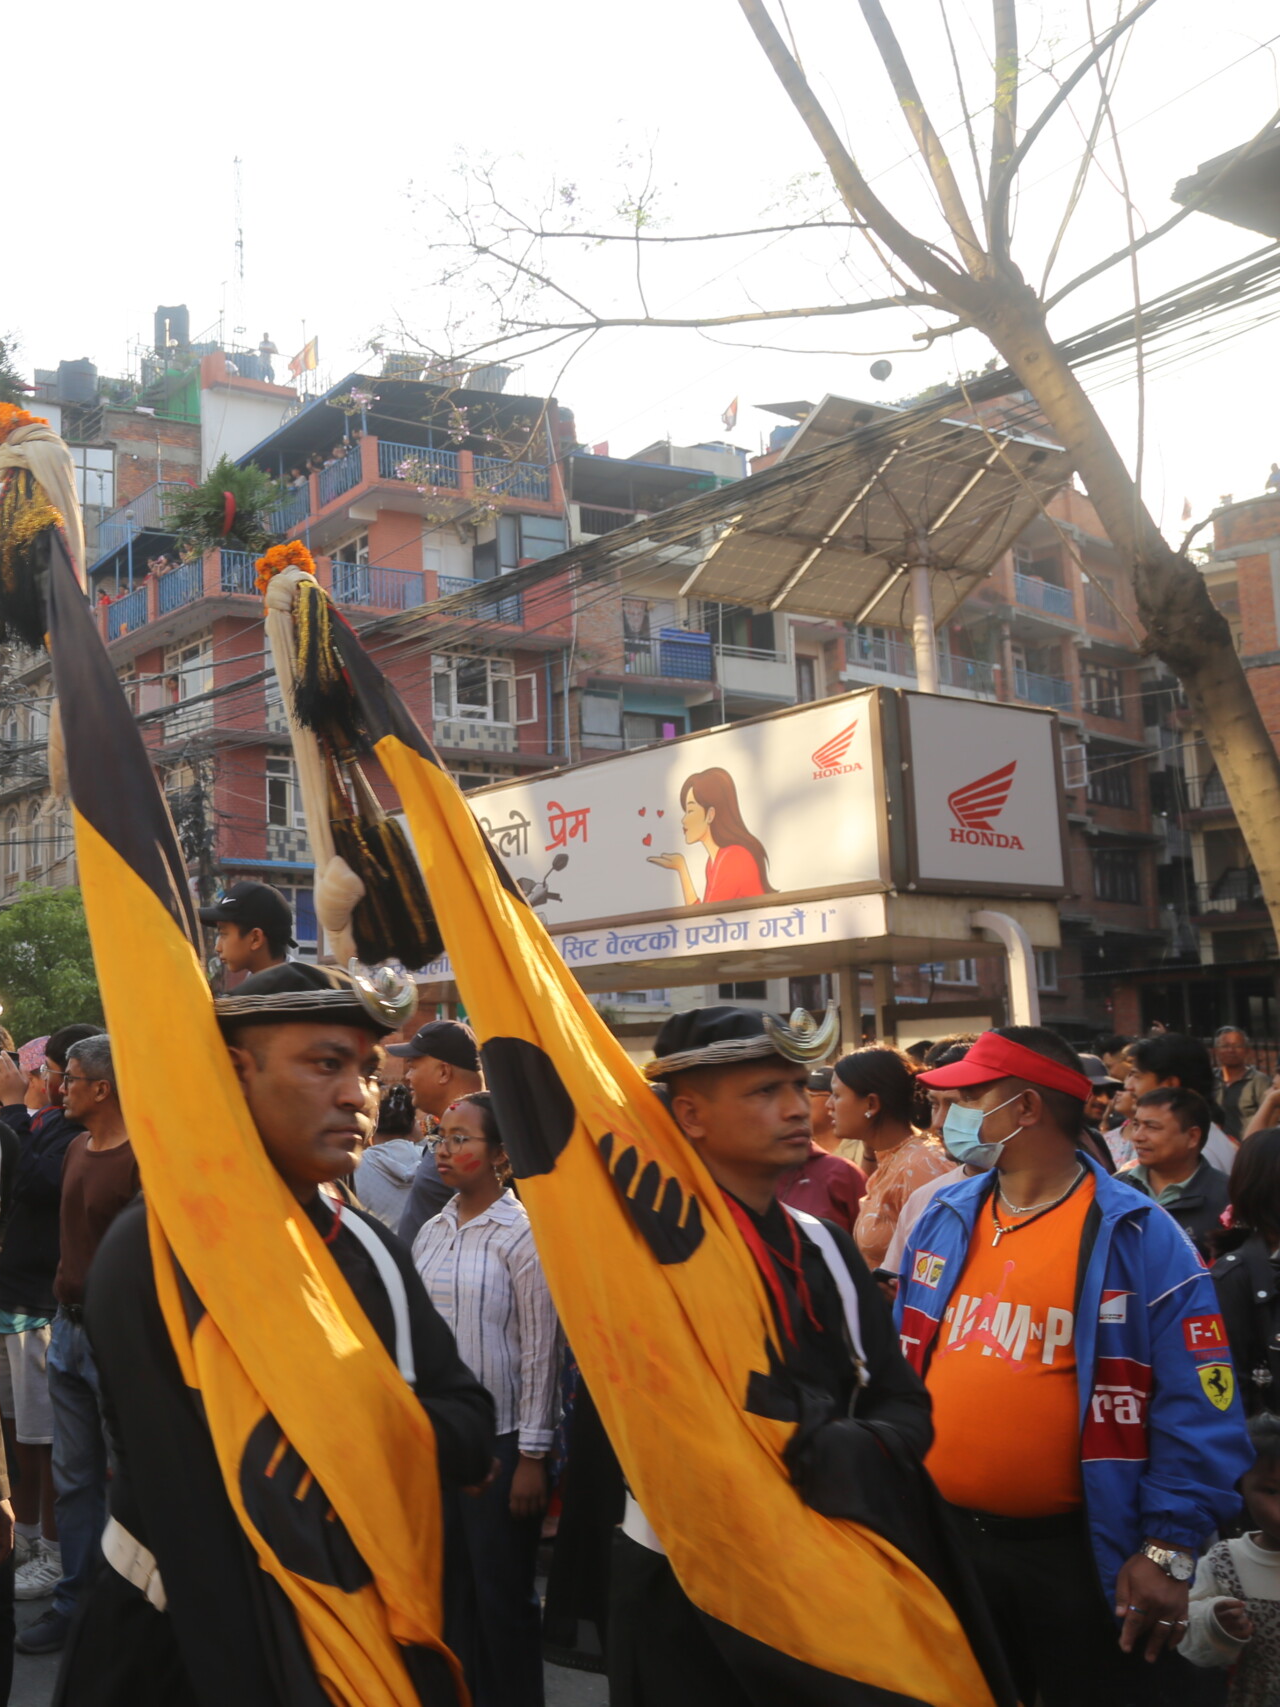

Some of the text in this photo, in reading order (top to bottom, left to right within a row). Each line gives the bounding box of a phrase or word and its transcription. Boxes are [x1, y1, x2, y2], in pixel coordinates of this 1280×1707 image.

[812, 762, 864, 781] HONDA
[545, 801, 591, 852] प्रेम
[948, 827, 1025, 851] HONDA
[562, 935, 599, 961] सिट
[685, 918, 750, 949] प्रयोग
[1189, 1320, 1222, 1344] F-1
